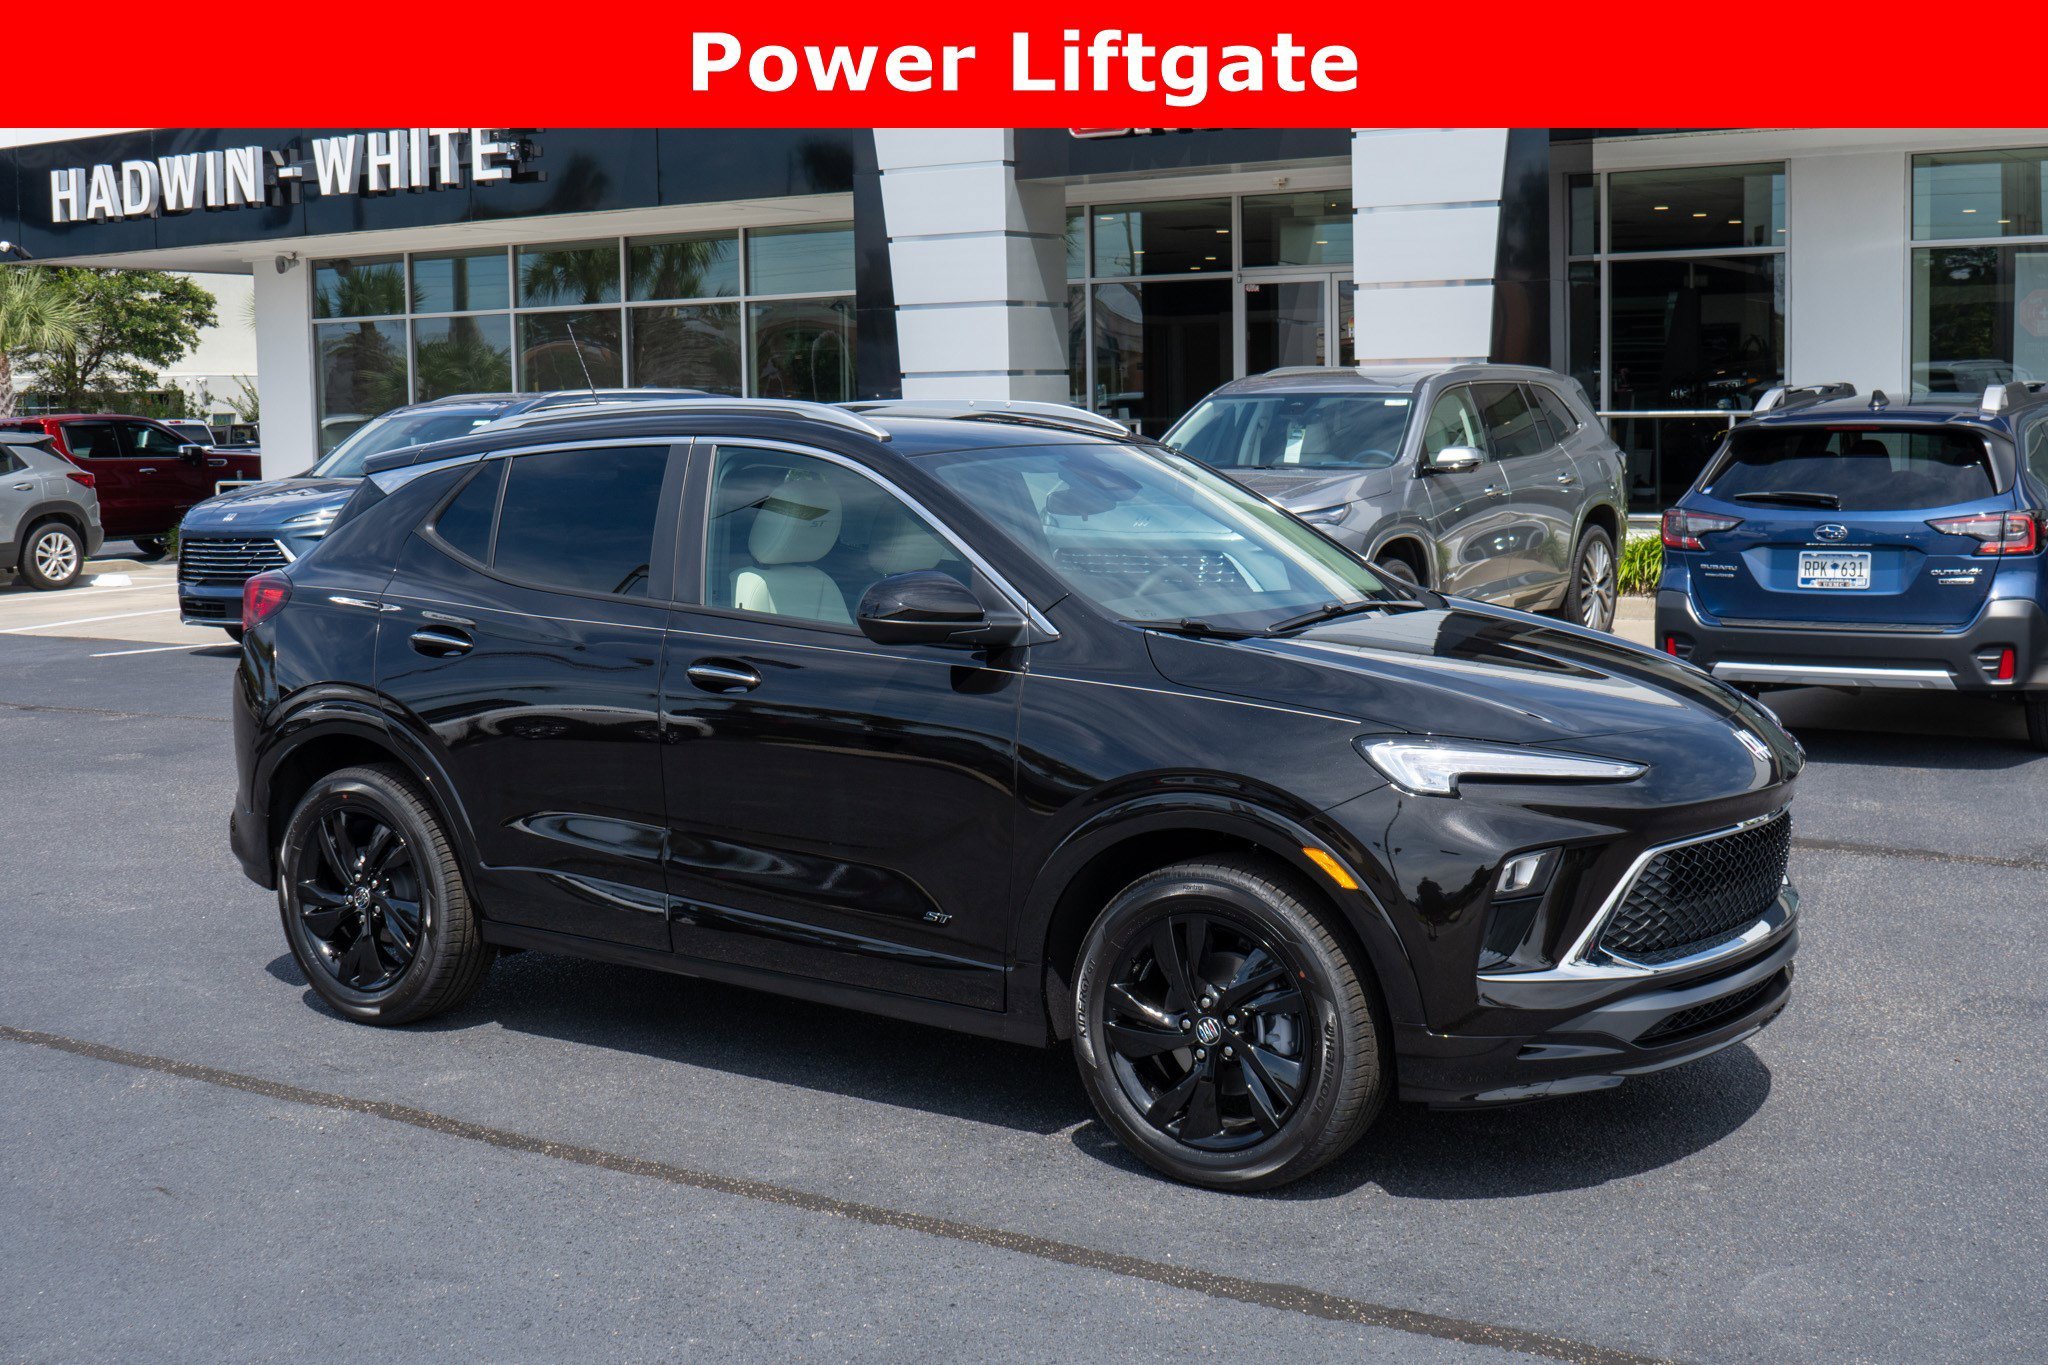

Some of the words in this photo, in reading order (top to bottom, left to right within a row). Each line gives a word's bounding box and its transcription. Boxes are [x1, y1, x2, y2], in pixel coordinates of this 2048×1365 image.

[50, 145, 265, 223] HADWIN
[312, 127, 512, 197] WHITE
[1803, 561, 1828, 577] RPK
[1840, 561, 1864, 577] 631
